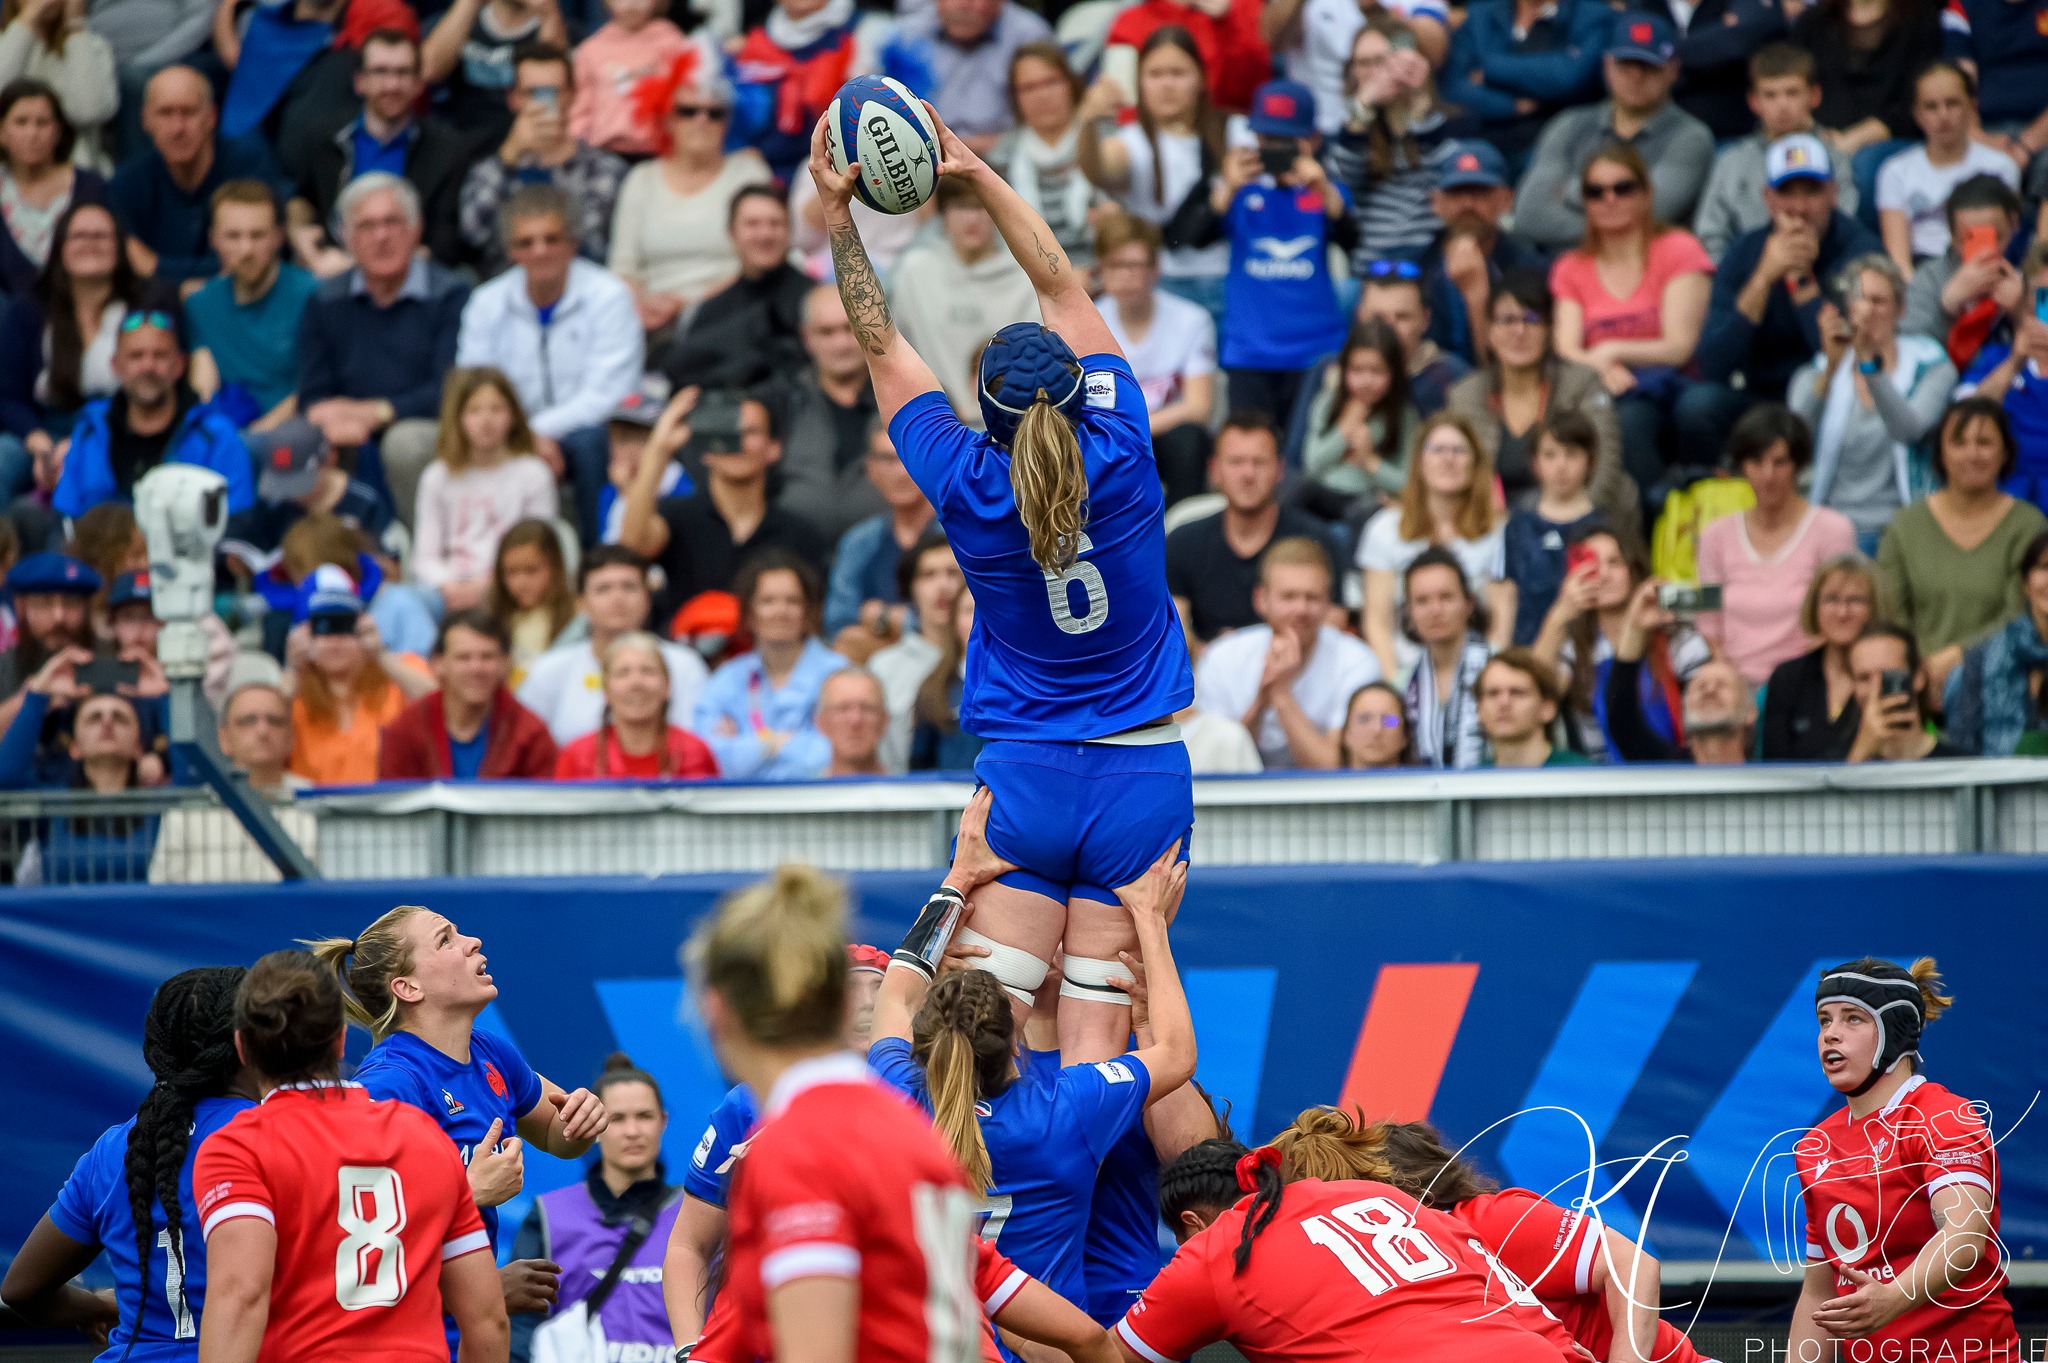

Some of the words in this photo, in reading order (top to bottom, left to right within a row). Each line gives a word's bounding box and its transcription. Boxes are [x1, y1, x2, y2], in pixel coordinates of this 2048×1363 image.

[868, 116, 921, 211] GILBERT
[1043, 530, 1109, 635] 6
[335, 1165, 408, 1311] 8
[1300, 1196, 1458, 1297] 18
